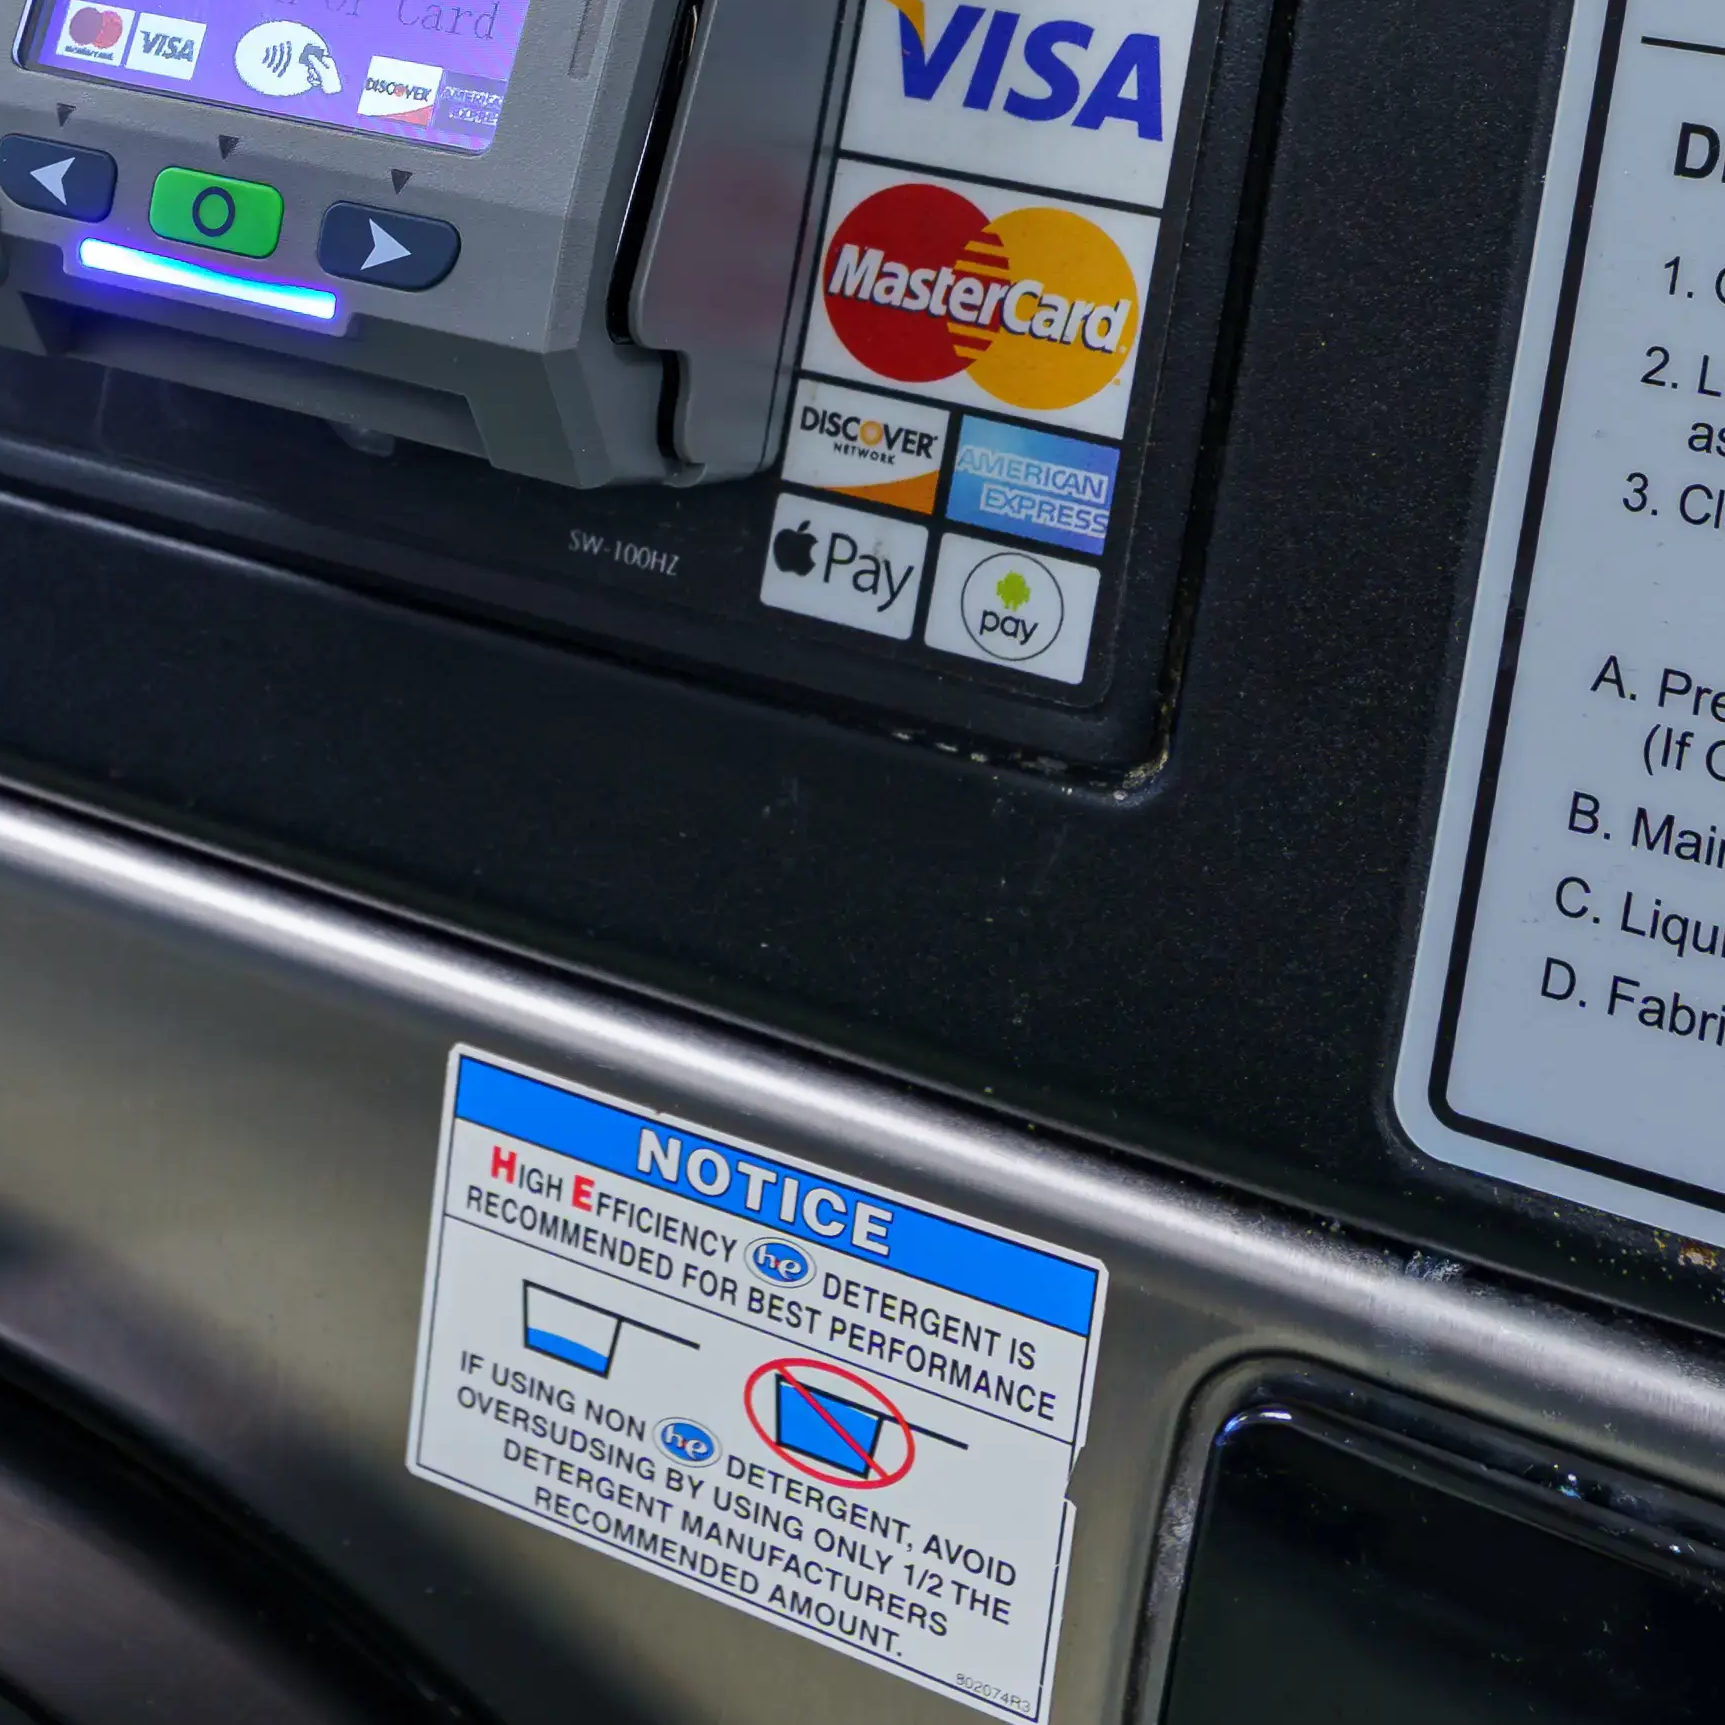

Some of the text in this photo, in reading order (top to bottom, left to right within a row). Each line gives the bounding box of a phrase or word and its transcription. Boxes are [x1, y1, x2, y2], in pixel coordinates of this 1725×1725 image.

[140, 30, 195, 63] VISA
[827, 242, 1133, 356] MasterCard
[1664, 256, 1694, 298] 1.
[1640, 346, 1678, 389] 2.
[799, 405, 935, 460] DISCOVER
[833, 442, 896, 466] NETWORK
[956, 446, 1108, 504] AMERICAN
[1622, 472, 1658, 516] 3.
[981, 484, 1110, 537] EXPRESS
[568, 528, 680, 577] SW-100HZ
[822, 532, 915, 613] Pay
[979, 609, 1039, 646] pay
[1590, 655, 1636, 701] A.
[1643, 724, 1694, 776] (If
[1568, 791, 1610, 840] B.
[1555, 876, 1600, 924] C.
[1541, 957, 1586, 1008] D.
[636, 1128, 894, 1257] NOTICE
[490, 1146, 563, 1202] HIGH
[572, 1175, 738, 1263] EFFICIENCY
[823, 1271, 1002, 1357] DETERGENT
[1009, 1338, 1036, 1371] IS
[466, 1184, 1057, 1422] RECOMMENDED FOR BEST PERFORMANCE
[461, 1350, 485, 1375] IF
[492, 1362, 576, 1414] USING
[585, 1399, 647, 1442] NON
[726, 1454, 913, 1553] DETERGENT,
[923, 1533, 1017, 1587] AVOID
[457, 1385, 1012, 1626] OVERSUDSING BY USING ONLY 1/2 THE
[504, 1437, 948, 1637] DETERGENT MANUFACTURERS
[535, 1485, 903, 1657] RECOMMENDED AMOUNT.
